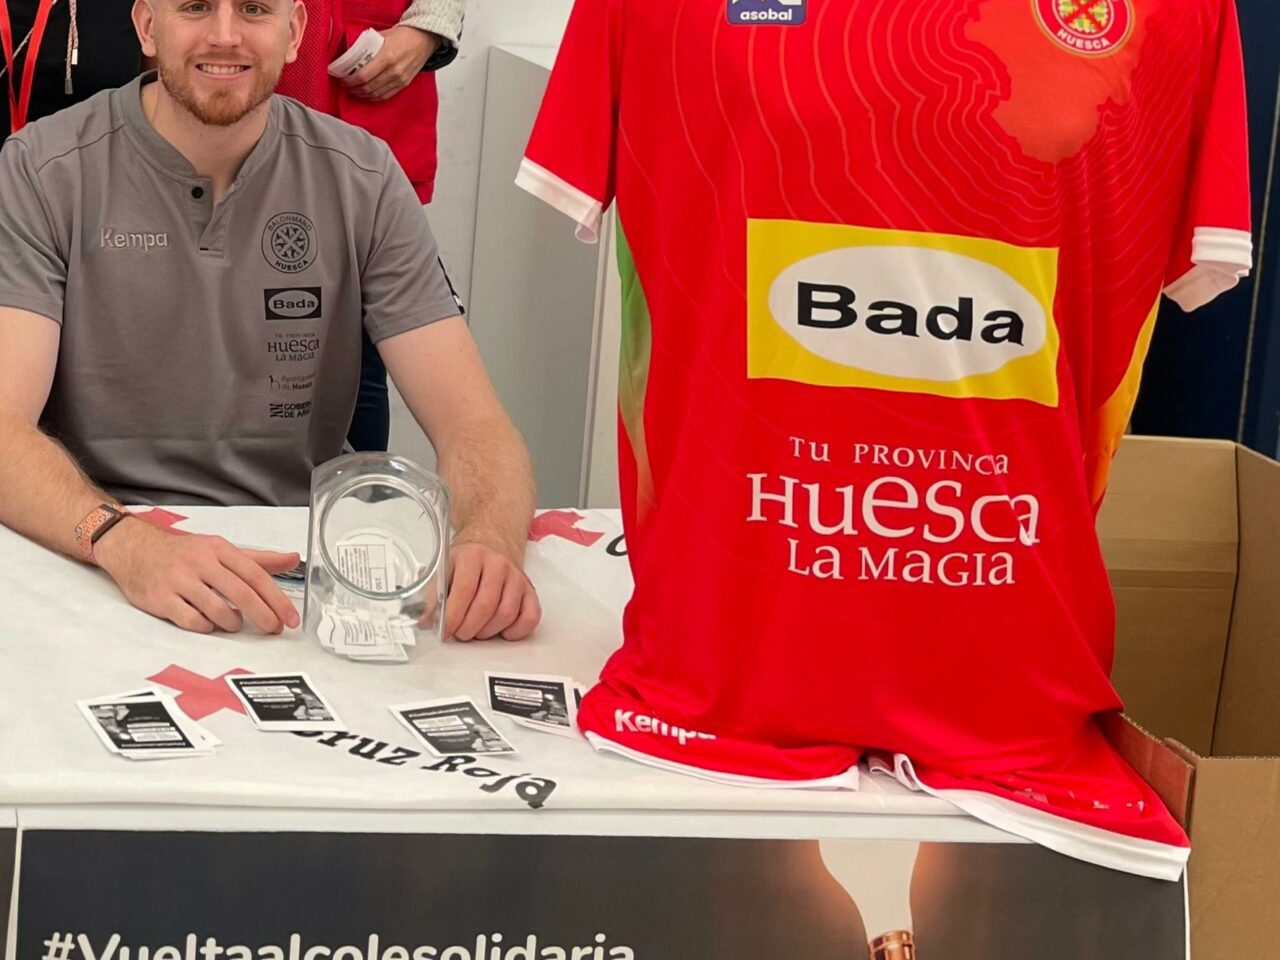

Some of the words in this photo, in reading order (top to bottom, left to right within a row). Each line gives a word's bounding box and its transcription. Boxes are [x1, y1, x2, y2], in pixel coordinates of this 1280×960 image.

[739, 8, 793, 21] asobal
[1055, 28, 1111, 51] HUESCA
[267, 215, 313, 232] BALONMANO
[100, 227, 168, 253] Kempa
[275, 259, 309, 271] HUESCA
[273, 298, 316, 310] Bada
[797, 280, 1025, 347] Bada
[284, 410, 295, 418] DE
[745, 472, 1041, 547] Huesca
[787, 537, 843, 582] La
[419, 754, 557, 809] Roja
